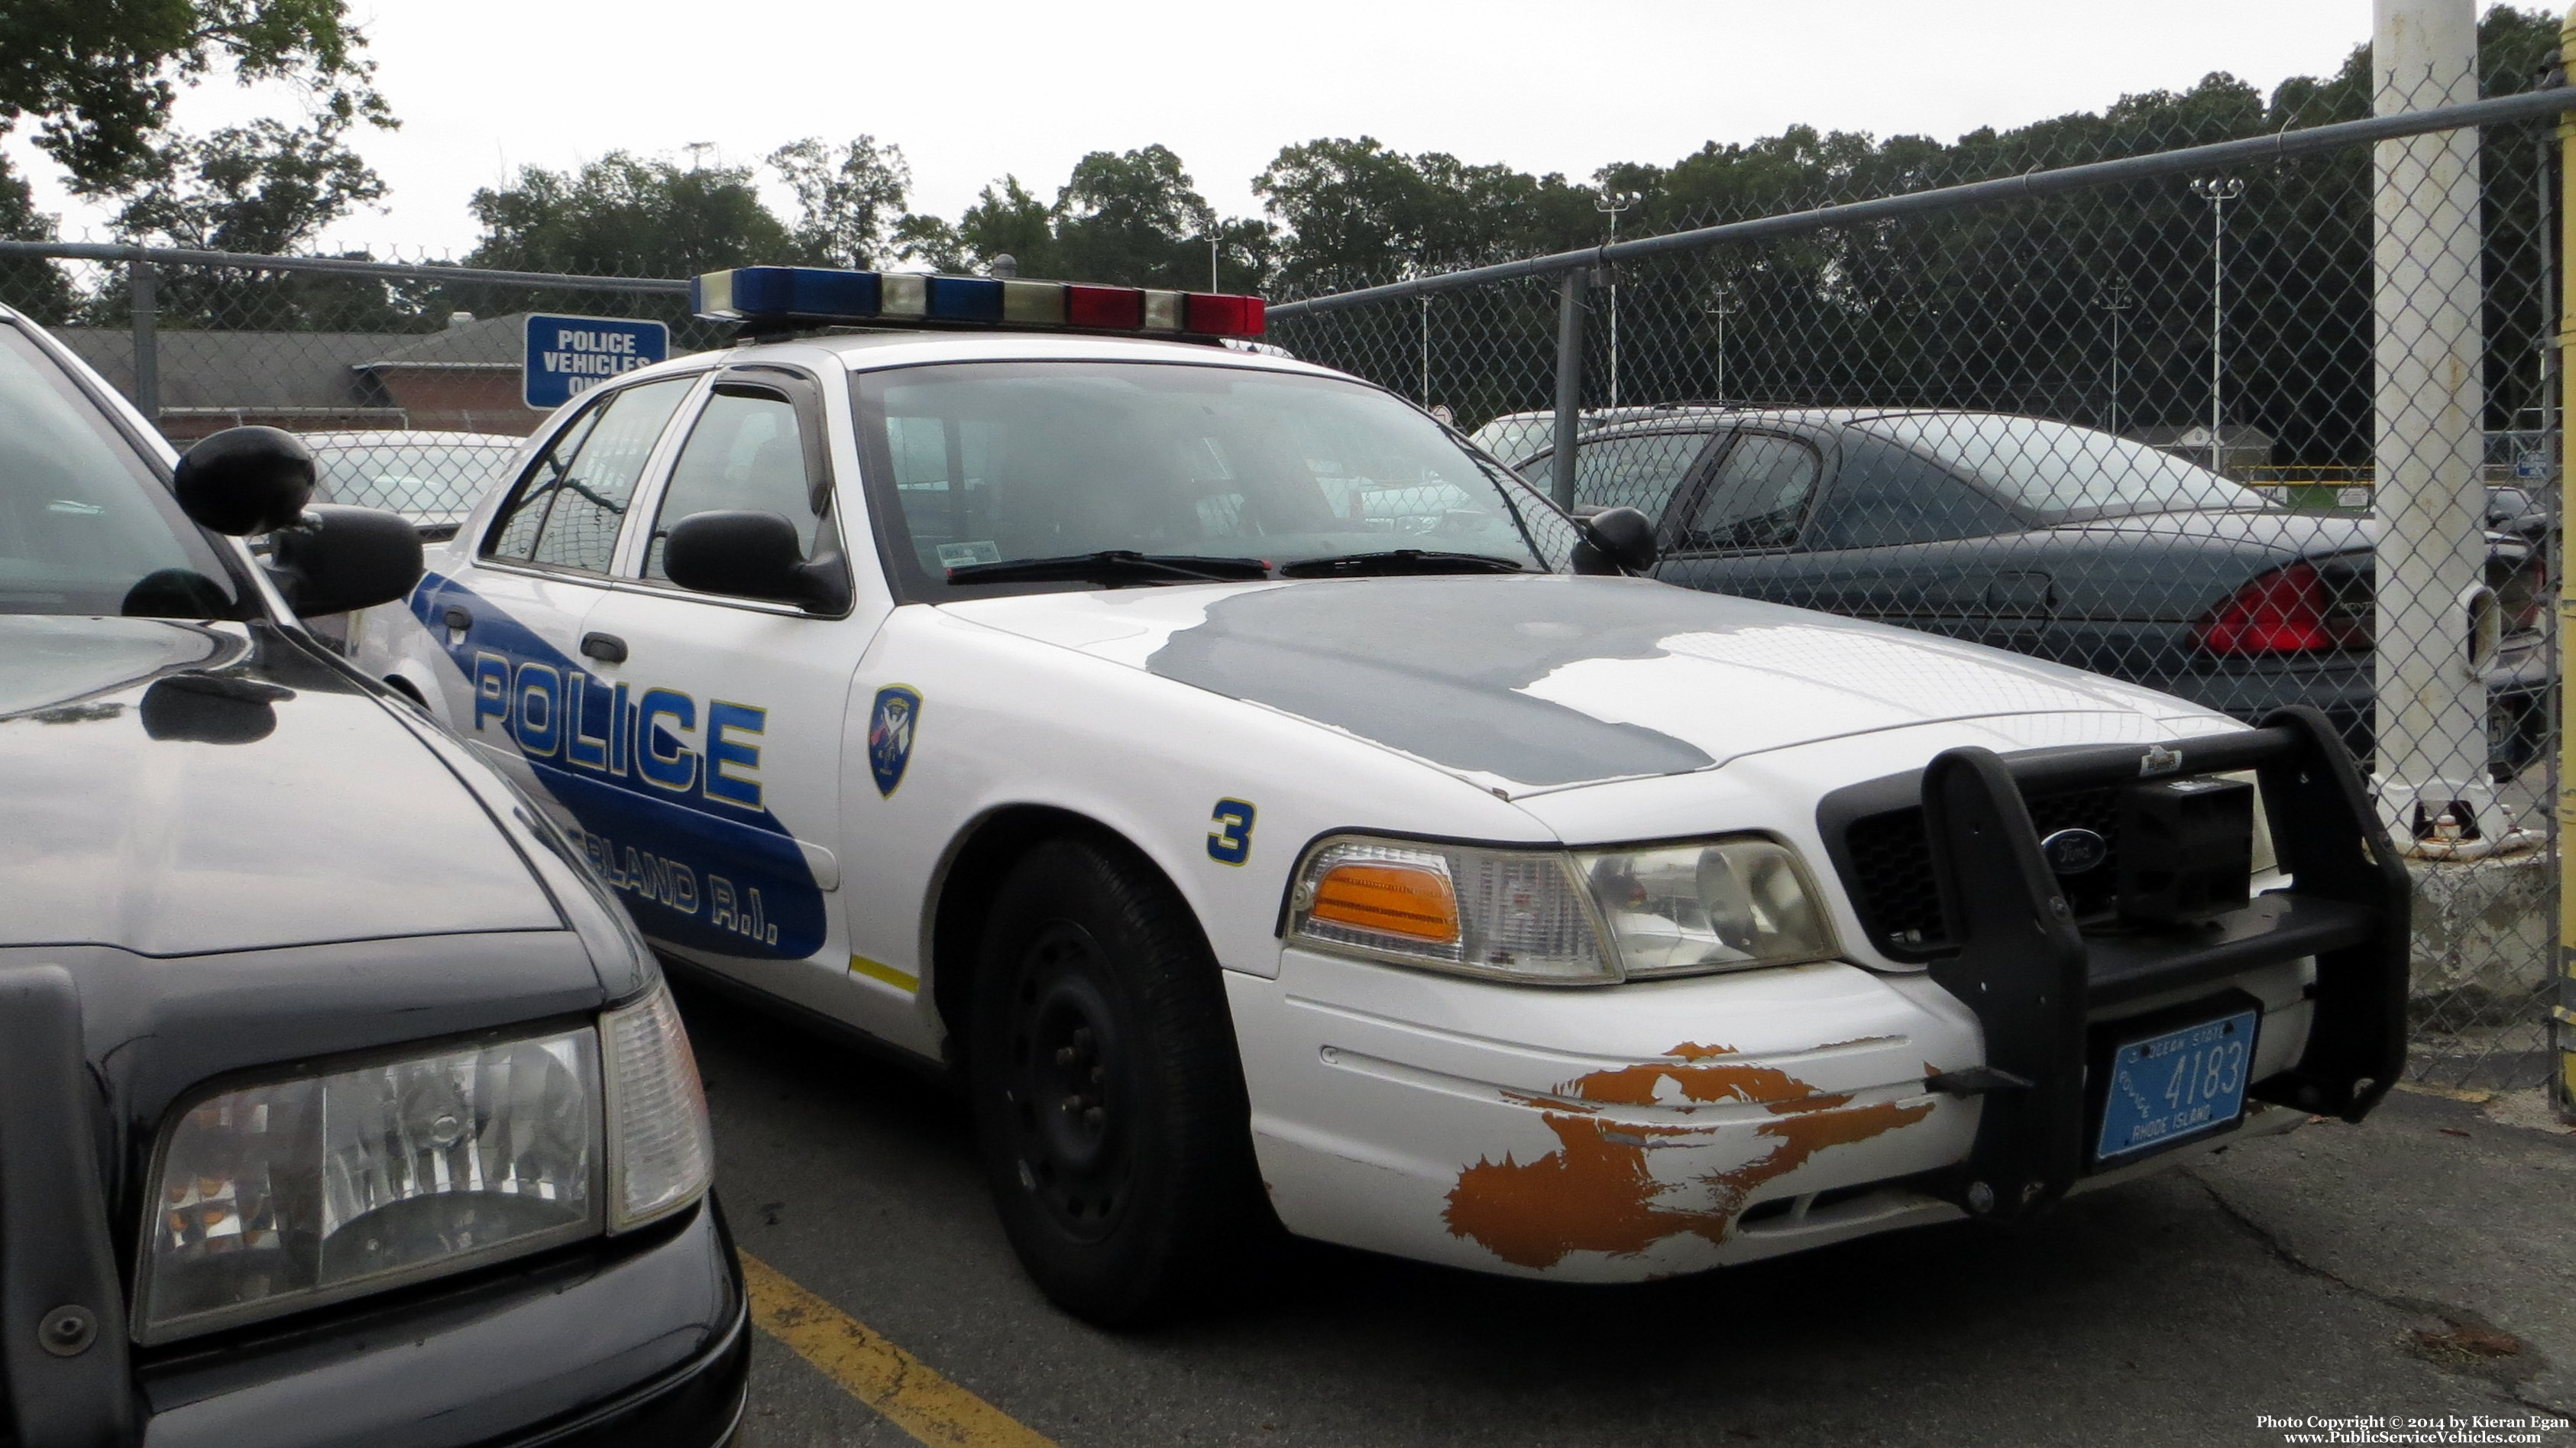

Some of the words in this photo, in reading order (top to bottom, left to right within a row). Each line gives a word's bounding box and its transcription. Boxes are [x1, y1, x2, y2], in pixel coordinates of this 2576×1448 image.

[558, 329, 636, 354] POLICE
[474, 651, 768, 813] POLICE
[1207, 797, 1257, 867] 3
[2058, 837, 2092, 863] Ford
[708, 874, 778, 945] R.I.
[2118, 1070, 2150, 1119] POLICE
[2164, 1041, 2242, 1109] 4183
[2132, 1116, 2169, 1142] RHODE
[2173, 1103, 2212, 1131] ISLAND
